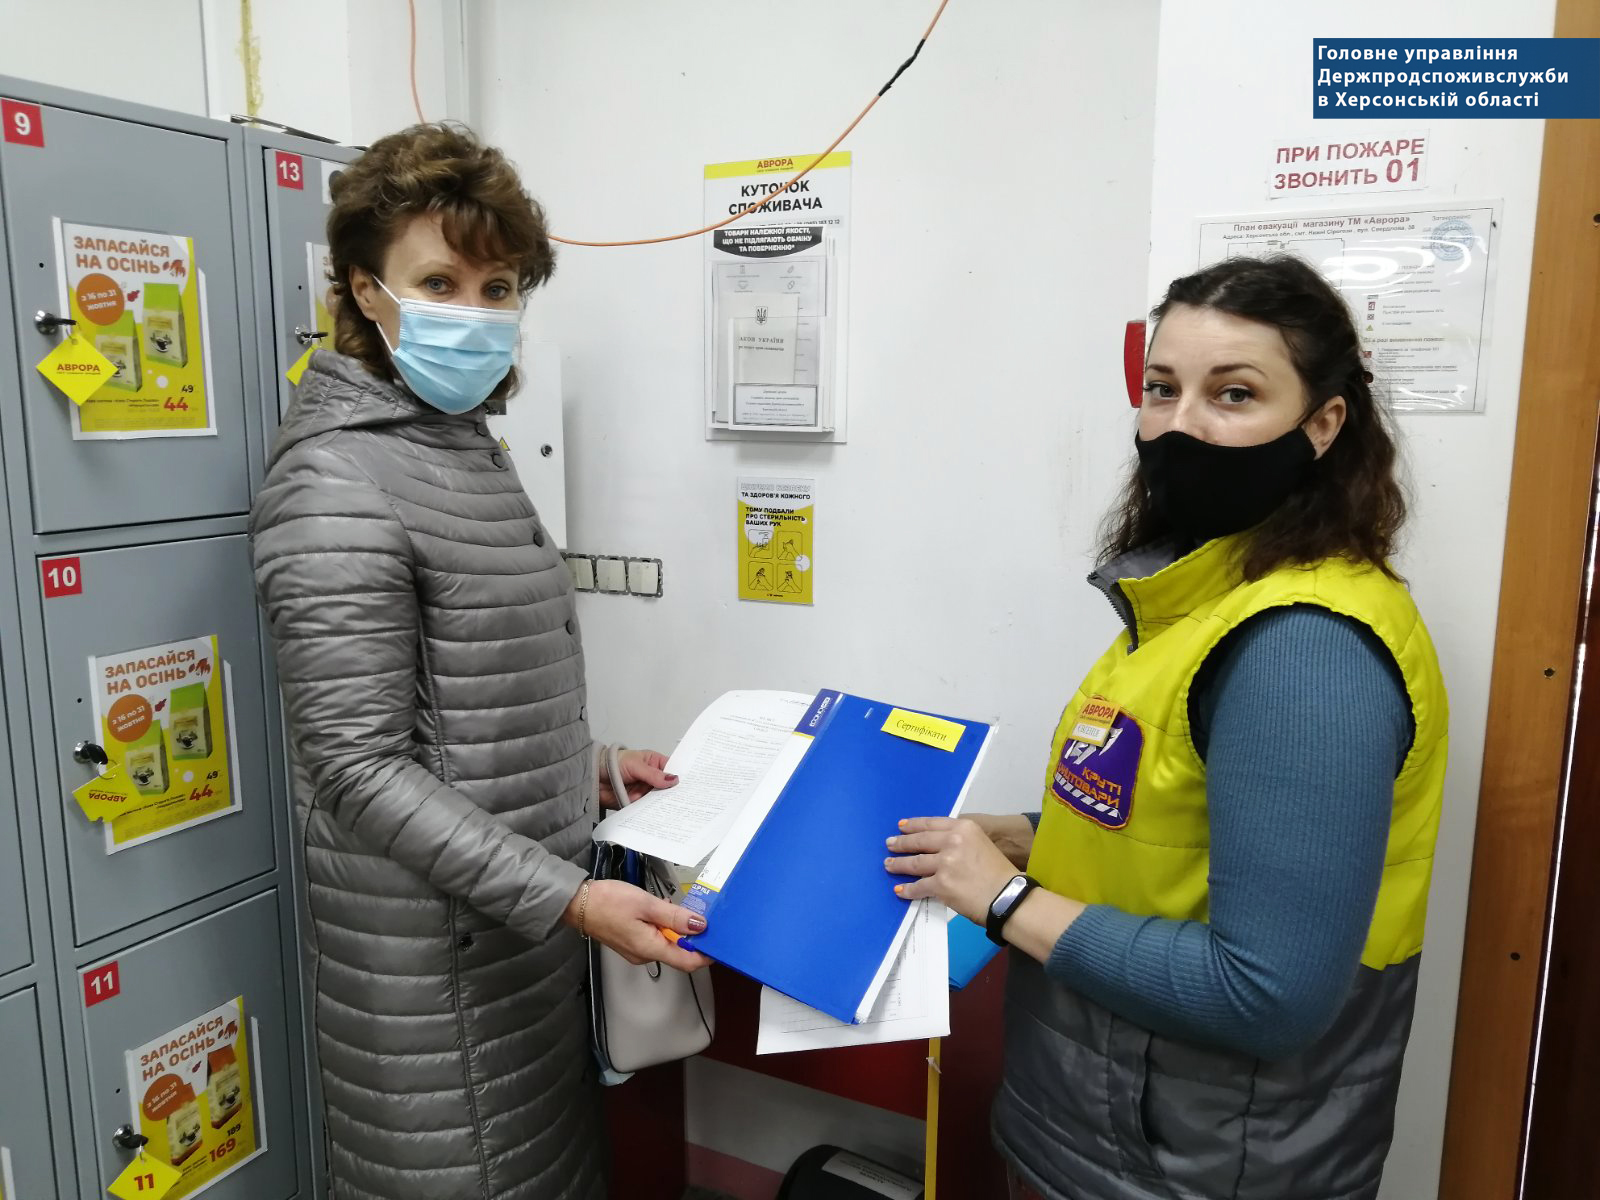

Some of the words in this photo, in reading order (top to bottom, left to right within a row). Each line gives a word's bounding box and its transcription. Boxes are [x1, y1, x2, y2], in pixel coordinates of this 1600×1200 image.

[14, 112, 31, 136] 9
[1276, 146, 1320, 164] ПРИ
[1327, 138, 1425, 160] ПОЖАРЕ
[279, 160, 300, 182] 13
[756, 158, 794, 169] АВРОРА
[1274, 168, 1378, 189] ЗВОНИТЬ
[1386, 157, 1419, 183] 01
[741, 180, 810, 197] КУТОЧОК
[728, 197, 823, 215] СПОЖИВАЧА
[73, 236, 170, 258] ЗАПАСАЙСЯ
[75, 253, 102, 269] НА
[106, 256, 161, 274] ОСІНЬ
[57, 363, 100, 372] АВРОРА
[181, 384, 194, 393] 49
[163, 396, 189, 411] 44
[48, 566, 77, 589] 10
[105, 649, 195, 679] ЗАПАСАЙСЯ
[106, 678, 132, 695] НА
[135, 667, 187, 688] ОСІНЬ
[1082, 703, 1115, 719] АВРОРА
[896, 719, 947, 742] Сертифікати
[206, 770, 218, 780] 49
[88, 792, 127, 803] АВРОРА
[189, 784, 214, 801] 44
[90, 970, 114, 996] 11
[140, 1015, 224, 1067] ЗАПАСАЙСЯ
[142, 1061, 165, 1081] НА
[169, 1036, 215, 1067] ОСІНЬ
[227, 1123, 241, 1137] 189
[209, 1137, 237, 1162] 169
[134, 1173, 155, 1191] 11
